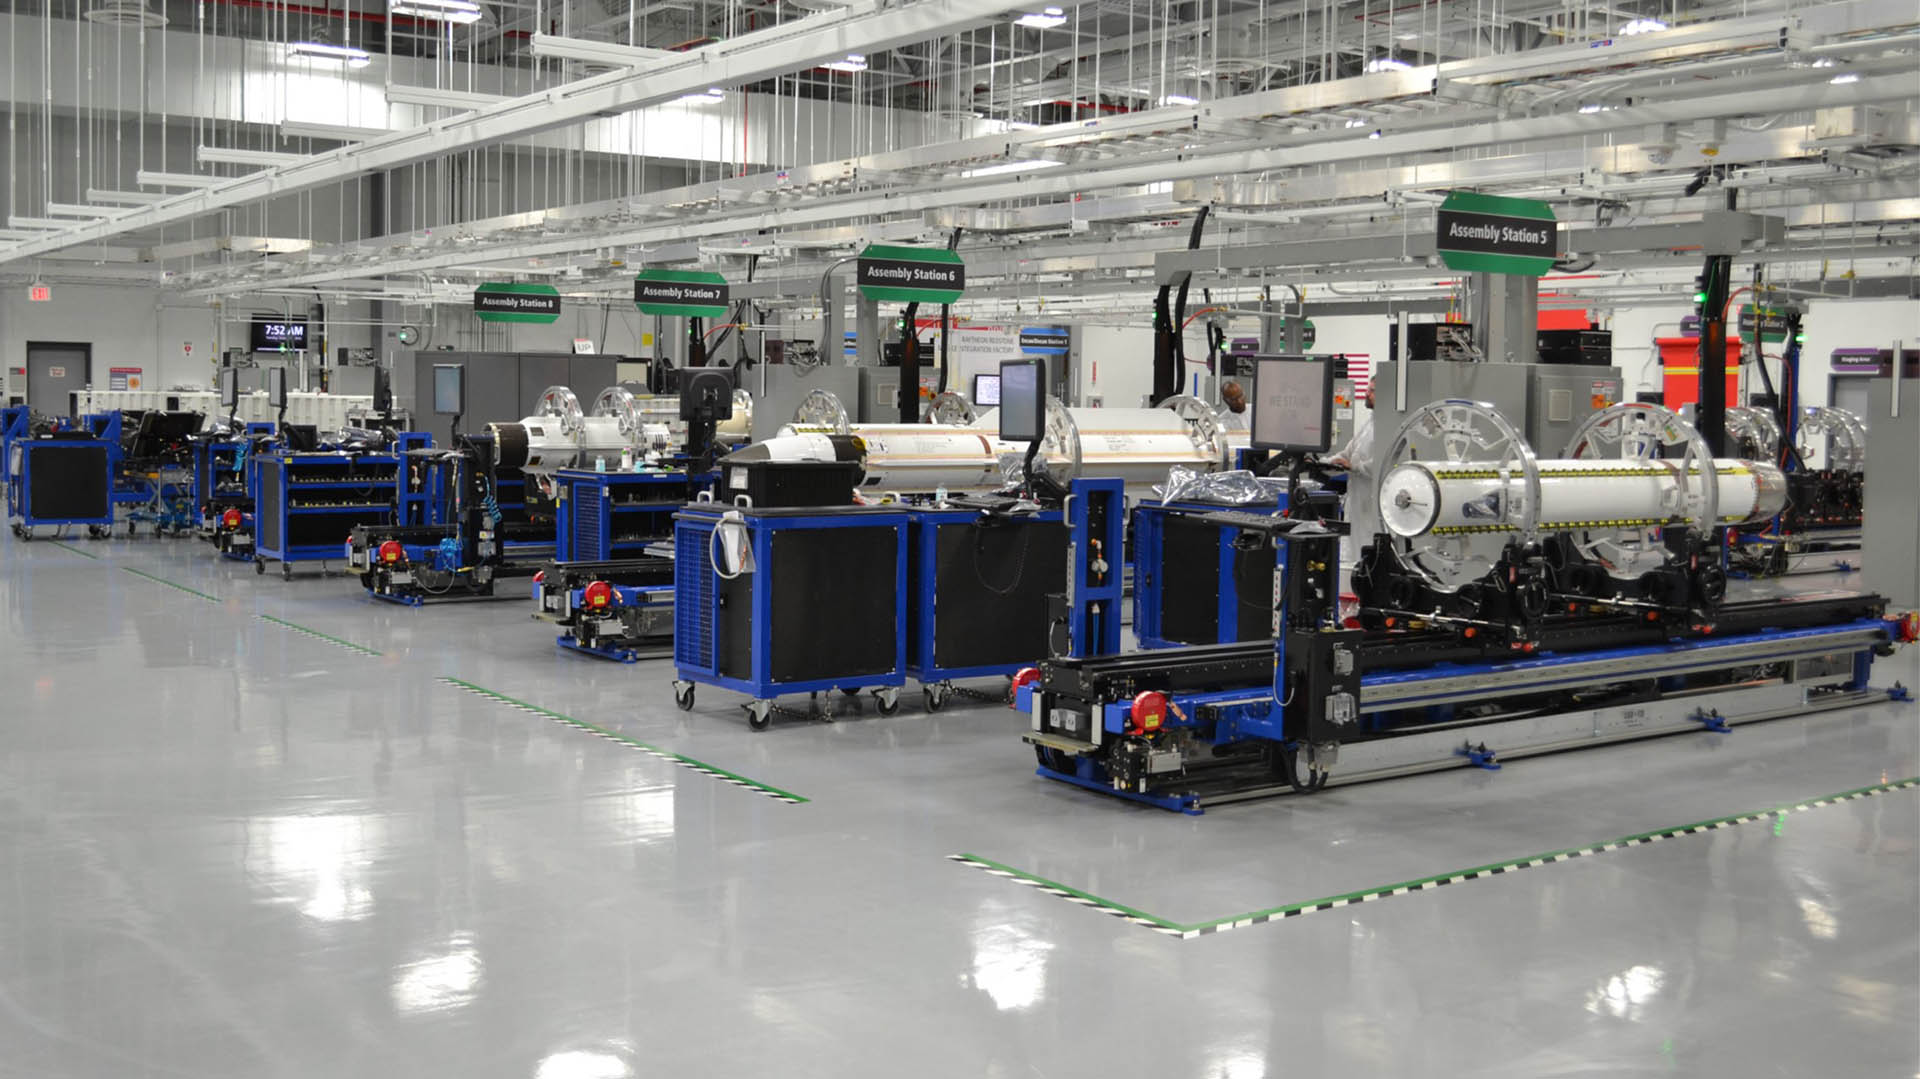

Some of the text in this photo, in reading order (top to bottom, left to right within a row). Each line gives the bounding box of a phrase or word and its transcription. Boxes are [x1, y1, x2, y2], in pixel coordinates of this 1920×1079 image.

[1449, 222, 1547, 244] Assembly Station 5
[867, 266, 955, 281] Assembly Station 6
[643, 286, 720, 299] Assembly Station 7
[482, 297, 518, 309] Assembly
[519, 298, 547, 308] Station
[265, 325, 303, 336] 7:52 AM
[576, 343, 591, 352] UP
